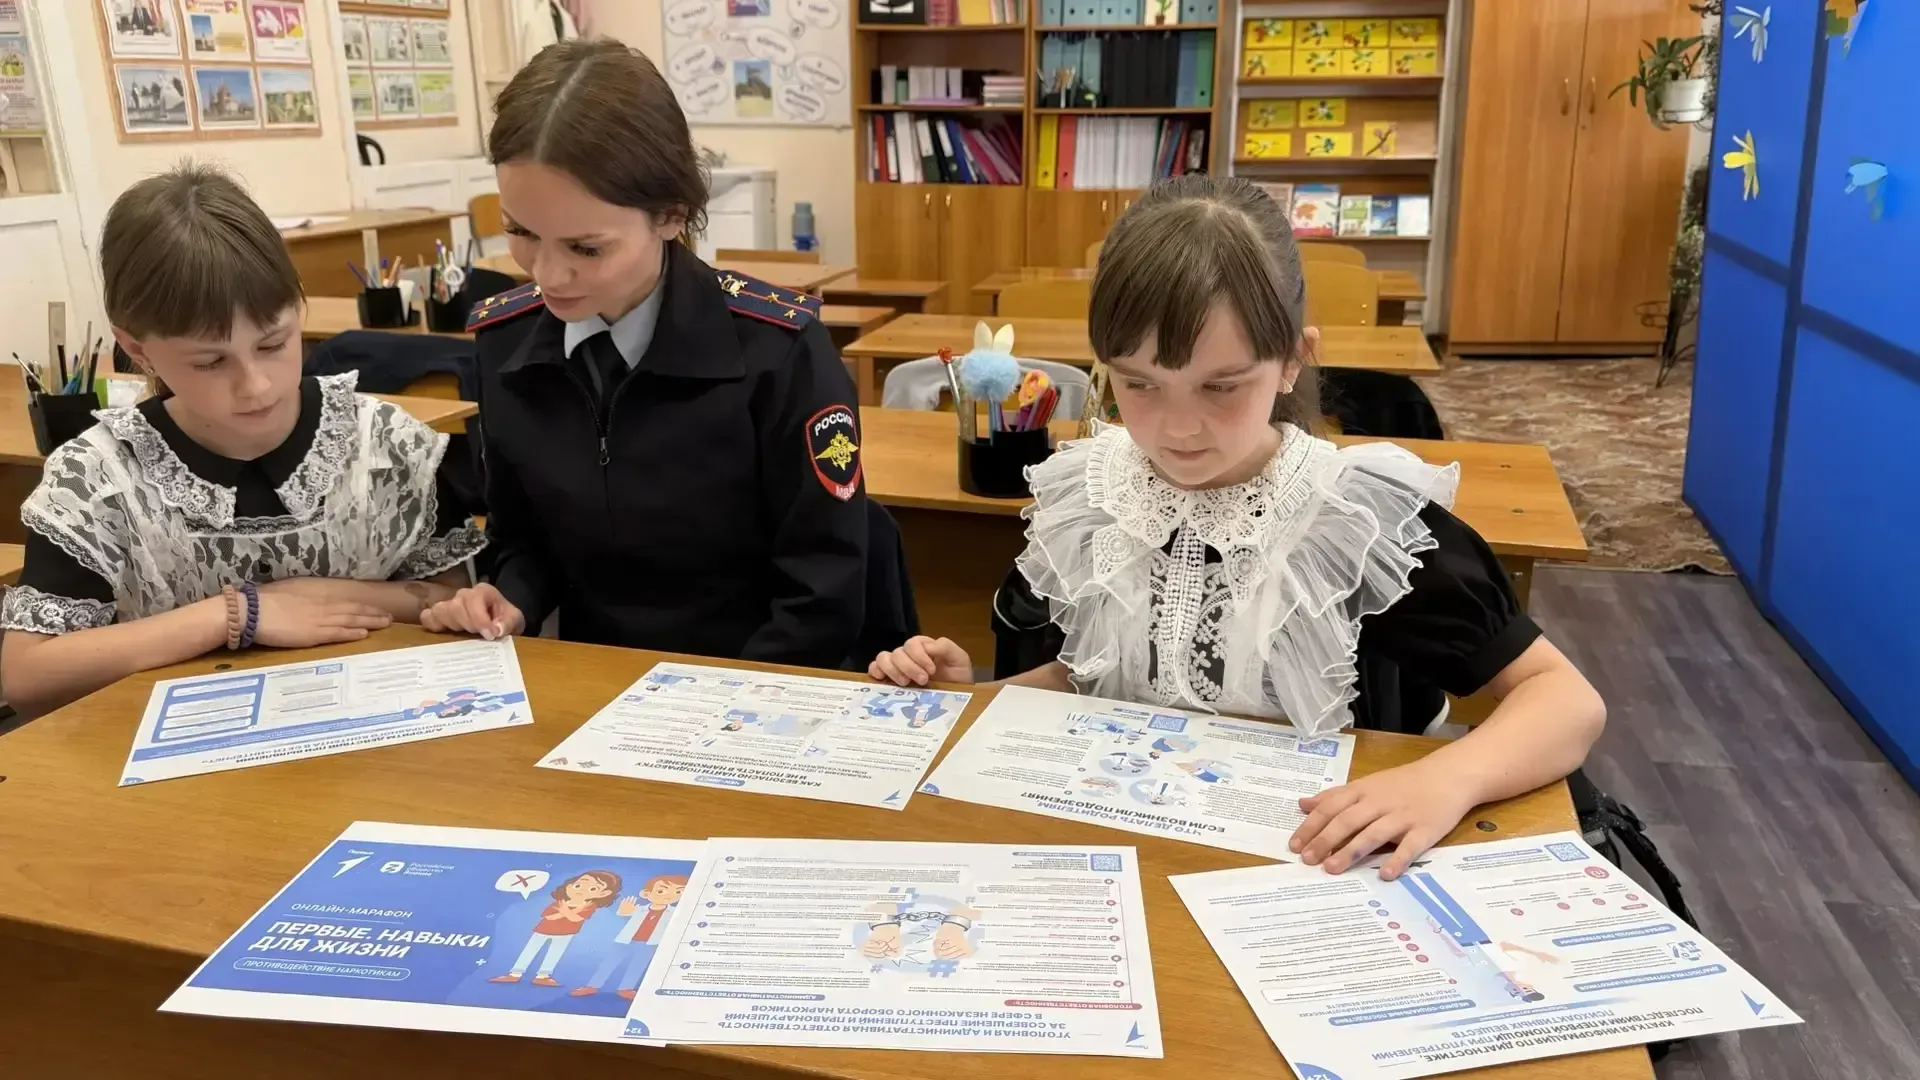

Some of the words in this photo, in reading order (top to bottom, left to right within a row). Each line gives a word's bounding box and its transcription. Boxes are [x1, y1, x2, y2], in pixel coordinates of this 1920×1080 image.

[814, 412, 853, 436] РОССИЯ
[835, 482, 855, 500] МВД
[635, 762, 701, 773] ПОДРАБОТКУ
[656, 759, 727, 770] НАРКОБИЗНЕС
[702, 769, 736, 777] НАЙТИ
[737, 768, 784, 777] ПОПАСТЬ
[737, 774, 798, 784] БЕЗОПАСНО
[1021, 792, 1113, 812] ПОДОЗРЕНИЯ?
[1037, 800, 1118, 820] РОДИТЕЛЯМ,
[1115, 809, 1187, 826] ВОЗНИКЛИ
[1120, 816, 1172, 830] ДЕЛАТЬ
[1174, 826, 1201, 836] ЧТО
[1188, 822, 1225, 832] ЕСЛИ
[291, 903, 413, 918] ОНЛАЙН-МАРАФОН
[267, 921, 372, 940] ПЕРВЫЕ.
[378, 930, 491, 948] НАВЫКИ
[1560, 936, 1601, 944] ОТРАВЛЕНИИ
[248, 935, 310, 951] ДЛЯ
[310, 940, 412, 958] ЖИЗНИ
[243, 960, 336, 973] ПРОТИВОДЕЙСТВИЕ
[335, 966, 401, 978] НАРКОТИКАМ
[1671, 967, 1719, 978] ДИАГНОСТИКА
[1623, 974, 1671, 984] ПОТРЕБЛЕНИЯ
[1579, 980, 1624, 990] НАРКОТИКОВ
[1424, 988, 1457, 996] СРЕДСТВ
[1361, 994, 1419, 1005] ПСИХОТРОПНЫХ
[1410, 994, 1462, 1004] НЕЗАКОННОГО
[752, 1005, 834, 1013] НАРКОТИКОВ
[1360, 1000, 1410, 1010] ПОТРЕБЛЕНИЯ
[1387, 1002, 1469, 1017] МЕДИКО-СОЦИАЛЬНЫЕ
[725, 1013, 845, 1023] ПРАВОНАРУШЕНИЙ
[897, 1010, 988, 1018] НЕЗАКОННОГО
[1299, 1007, 1360, 1018] НАРКОТИЧЕСКИХ
[1608, 1008, 1703, 1024] ПОСЛЕДСТВИЯМ
[858, 1017, 958, 1026] ПРЕСТУПЛЕНИЙ
[961, 1020, 1046, 1028] СОВЕРШЕНИЕ
[1334, 1014, 1387, 1024] ПОСЛЕДСТВИЯ
[1509, 1010, 1614, 1029] ПСИХОАКТИВНЫХ
[718, 1022, 840, 1032] ОТВЕТСТВЕННОСТЬ
[843, 1026, 980, 1036] АДМИНИСТРАТИВНАЯ
[1049, 1022, 1066, 1030] ЗА
[1451, 1024, 1509, 1038] ВЕЩЕСТВ
[1551, 1021, 1599, 1034] ПЕРВОЙ
[1619, 1020, 1675, 1032] КРАТКАЯ
[994, 1030, 1070, 1038] УГОЛОВНАЯ
[1493, 1028, 1552, 1041] ПОМОЩИ
[1534, 1028, 1620, 1044] ИНФОРМАЦИЯ
[1467, 1036, 1494, 1045] ПРИ
[1515, 1039, 1535, 1047] ПО
[1372, 1041, 1468, 1060] УПОТРЕБЛЕНИИ
[1417, 1041, 1514, 1062] ДИАГНОСТИКЕ,
